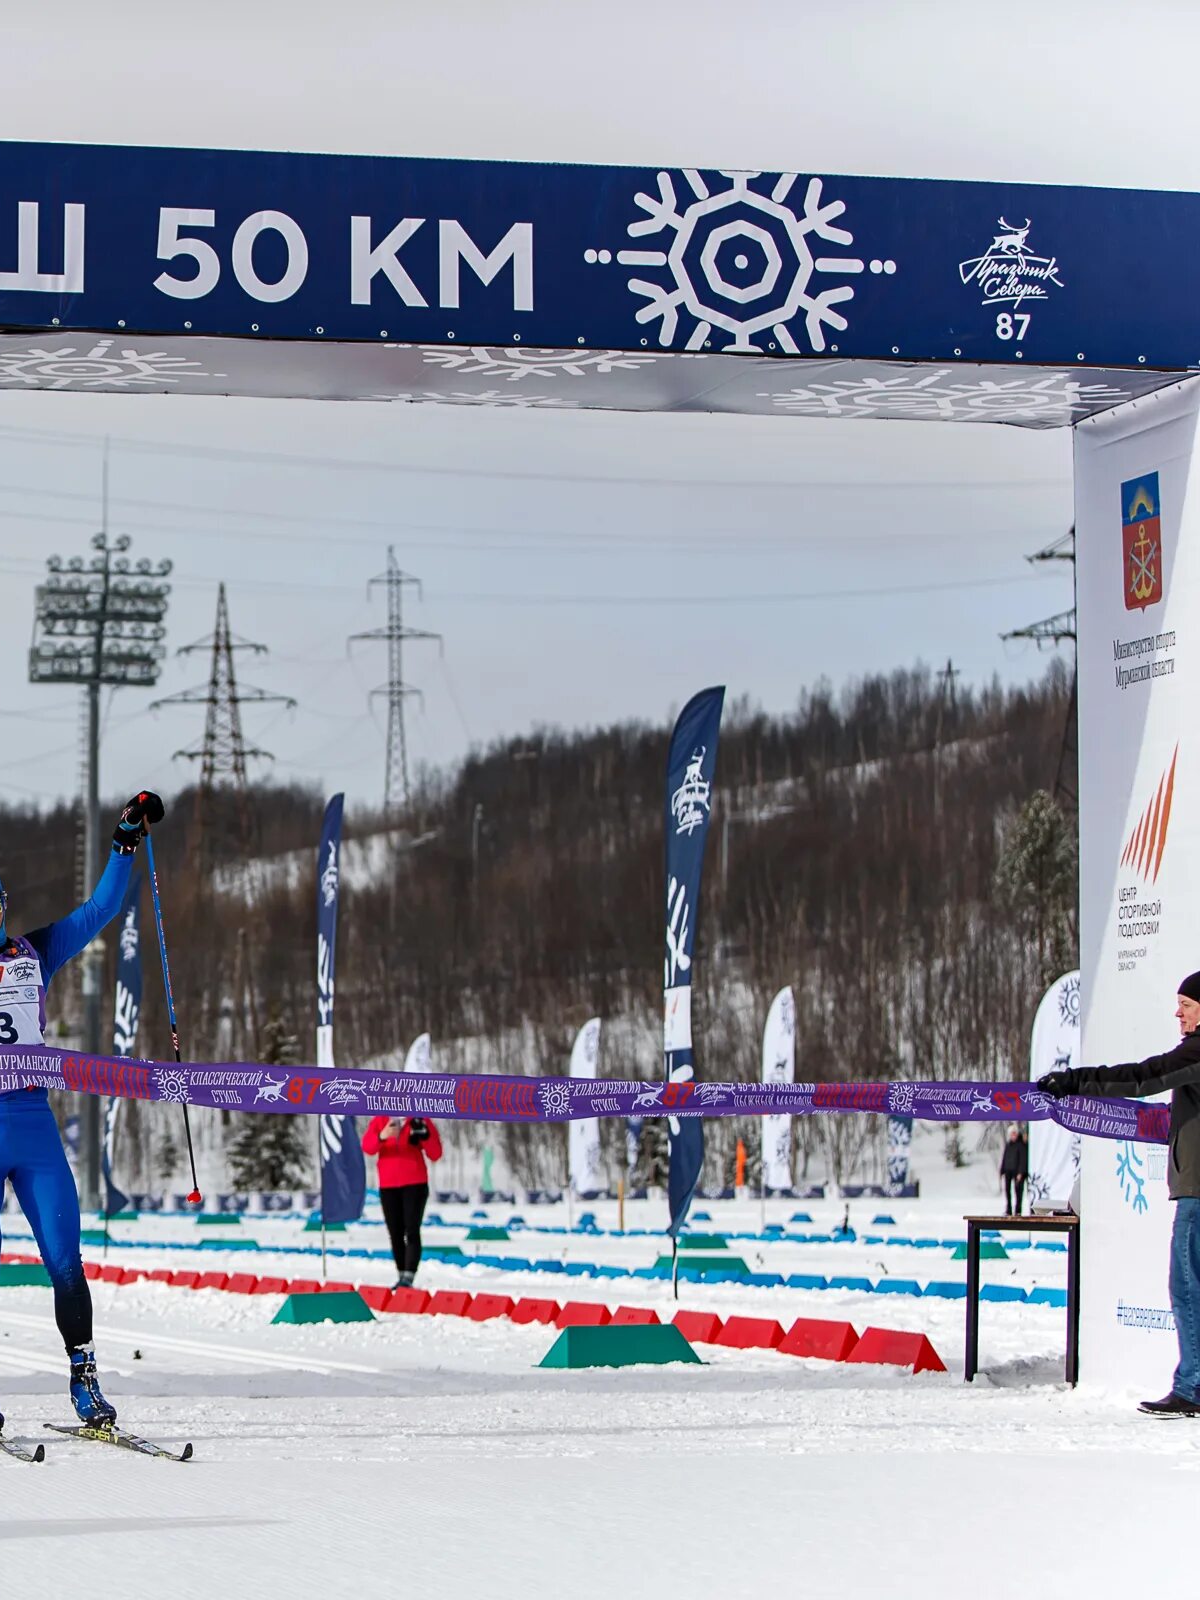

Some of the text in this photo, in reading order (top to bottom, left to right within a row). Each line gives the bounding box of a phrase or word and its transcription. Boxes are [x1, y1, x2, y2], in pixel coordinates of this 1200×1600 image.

[153, 207, 309, 304] 50
[350, 215, 534, 312] КМ
[959, 253, 1064, 288] Праздник
[982, 278, 1049, 309] Севера
[996, 313, 1031, 340] 87
[1112, 639, 1155, 660] Министерство
[1118, 886, 1137, 903] ЦЕНТР
[1118, 899, 1162, 920] СПОРТИВНОЙ
[1117, 921, 1160, 939] ПОДГОТОВКИ
[190, 1070, 263, 1086] КЛАССИЧЕСКИЙ
[369, 1077, 457, 1095] 48-й МУРМАНСКИЙ
[211, 1089, 242, 1104] СТИЛЬ
[287, 1077, 322, 1104] 87
[455, 1079, 538, 1117] ФИНИШ
[663, 1082, 695, 1107] 87
[915, 1088, 974, 1102] КЛАССИЧЕСКИЙ
[366, 1095, 456, 1113] ЛЫЖНЫЙ МАРАФОН
[590, 1098, 620, 1112] СТИЛЬ
[932, 1103, 961, 1115] СТИЛЬ
[994, 1091, 1022, 1112] 87
[1082, 1098, 1138, 1121] МУРМАНСКИЙ
[1100, 1118, 1138, 1137] МАРАФОН
